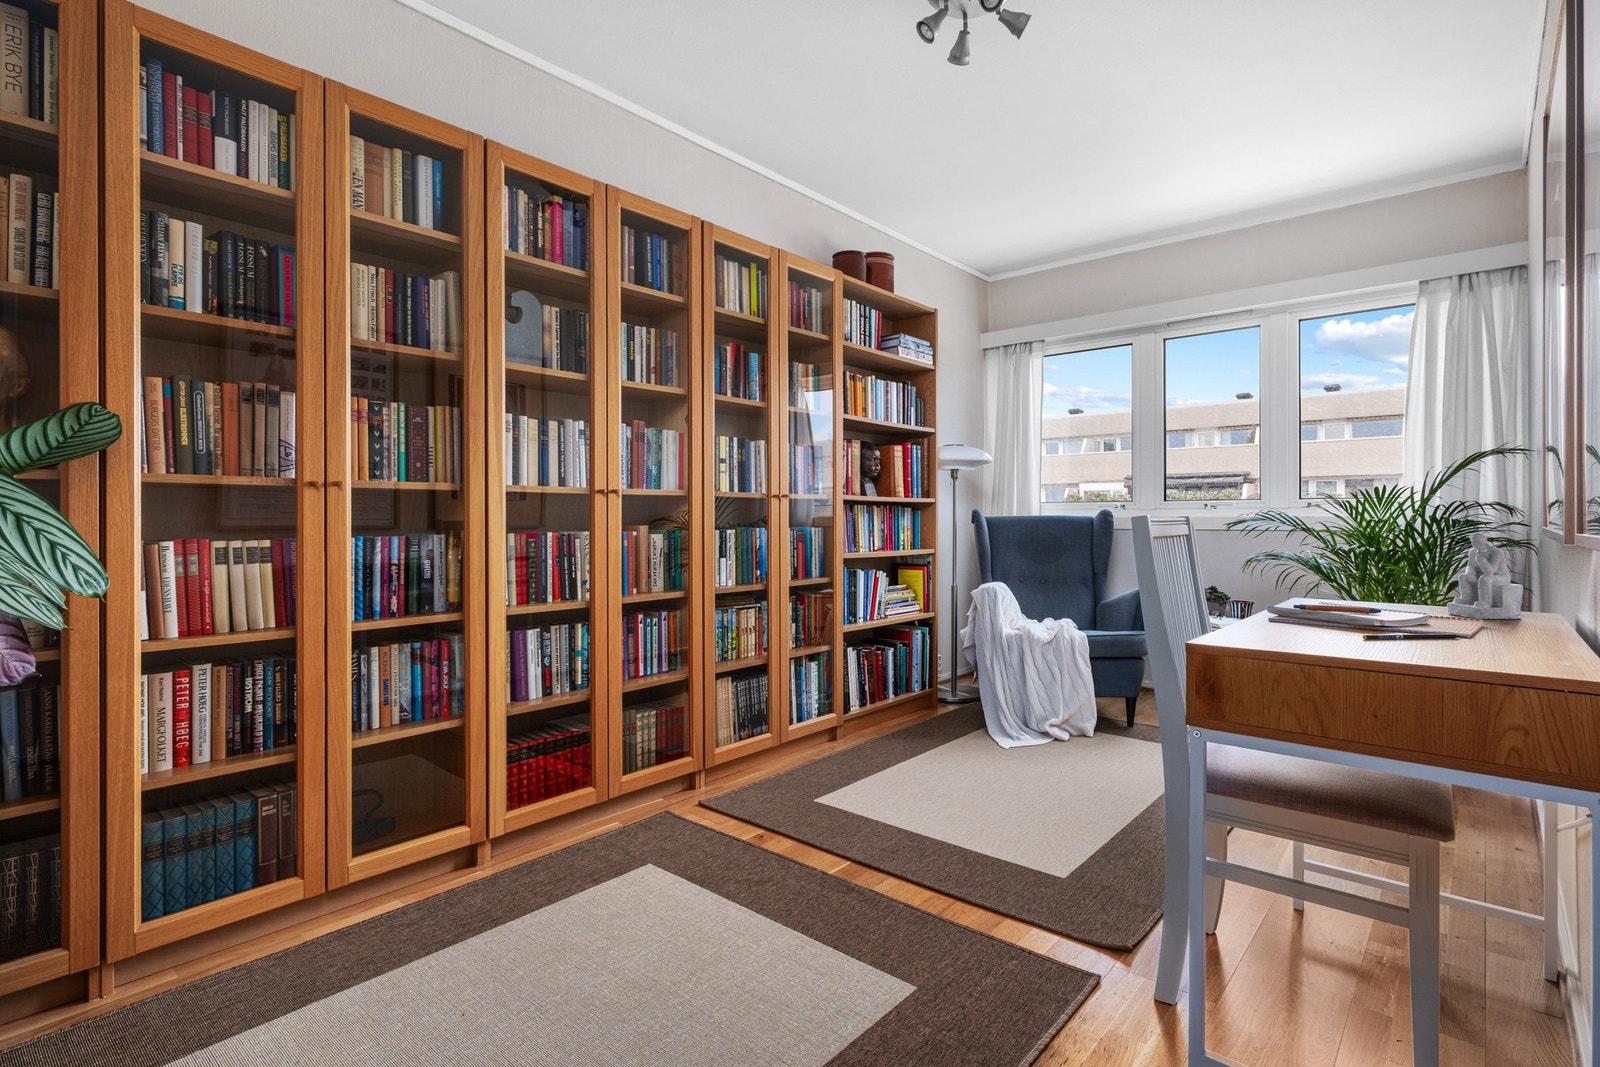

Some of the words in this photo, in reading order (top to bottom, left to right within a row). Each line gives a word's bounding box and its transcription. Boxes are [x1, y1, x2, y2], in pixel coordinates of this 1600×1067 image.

[5, 24, 22, 60] ERIK
[5, 62, 22, 94] BYE
[280, 122, 288, 162] FALDBAKKEN
[37, 193, 51, 208] GERD
[36, 208, 51, 243] BRANTENBERG
[157, 218, 165, 241] GILLIAN
[247, 247, 255, 278] FOSSUM
[178, 276, 184, 285] OG
[149, 399, 160, 426] BURGERS
[151, 428, 161, 451] DATTER
[198, 668, 208, 691] PETER
[44, 690, 53, 710] ANNE
[176, 677, 189, 710] PETER
[198, 692, 208, 713] HØEG
[45, 711, 53, 734] KARIN
[156, 707, 167, 764] MARGFOLKET
[176, 721, 189, 749] HØEG
[45, 735, 53, 762] ELSTAD
[44, 764, 53, 784] JULIE
